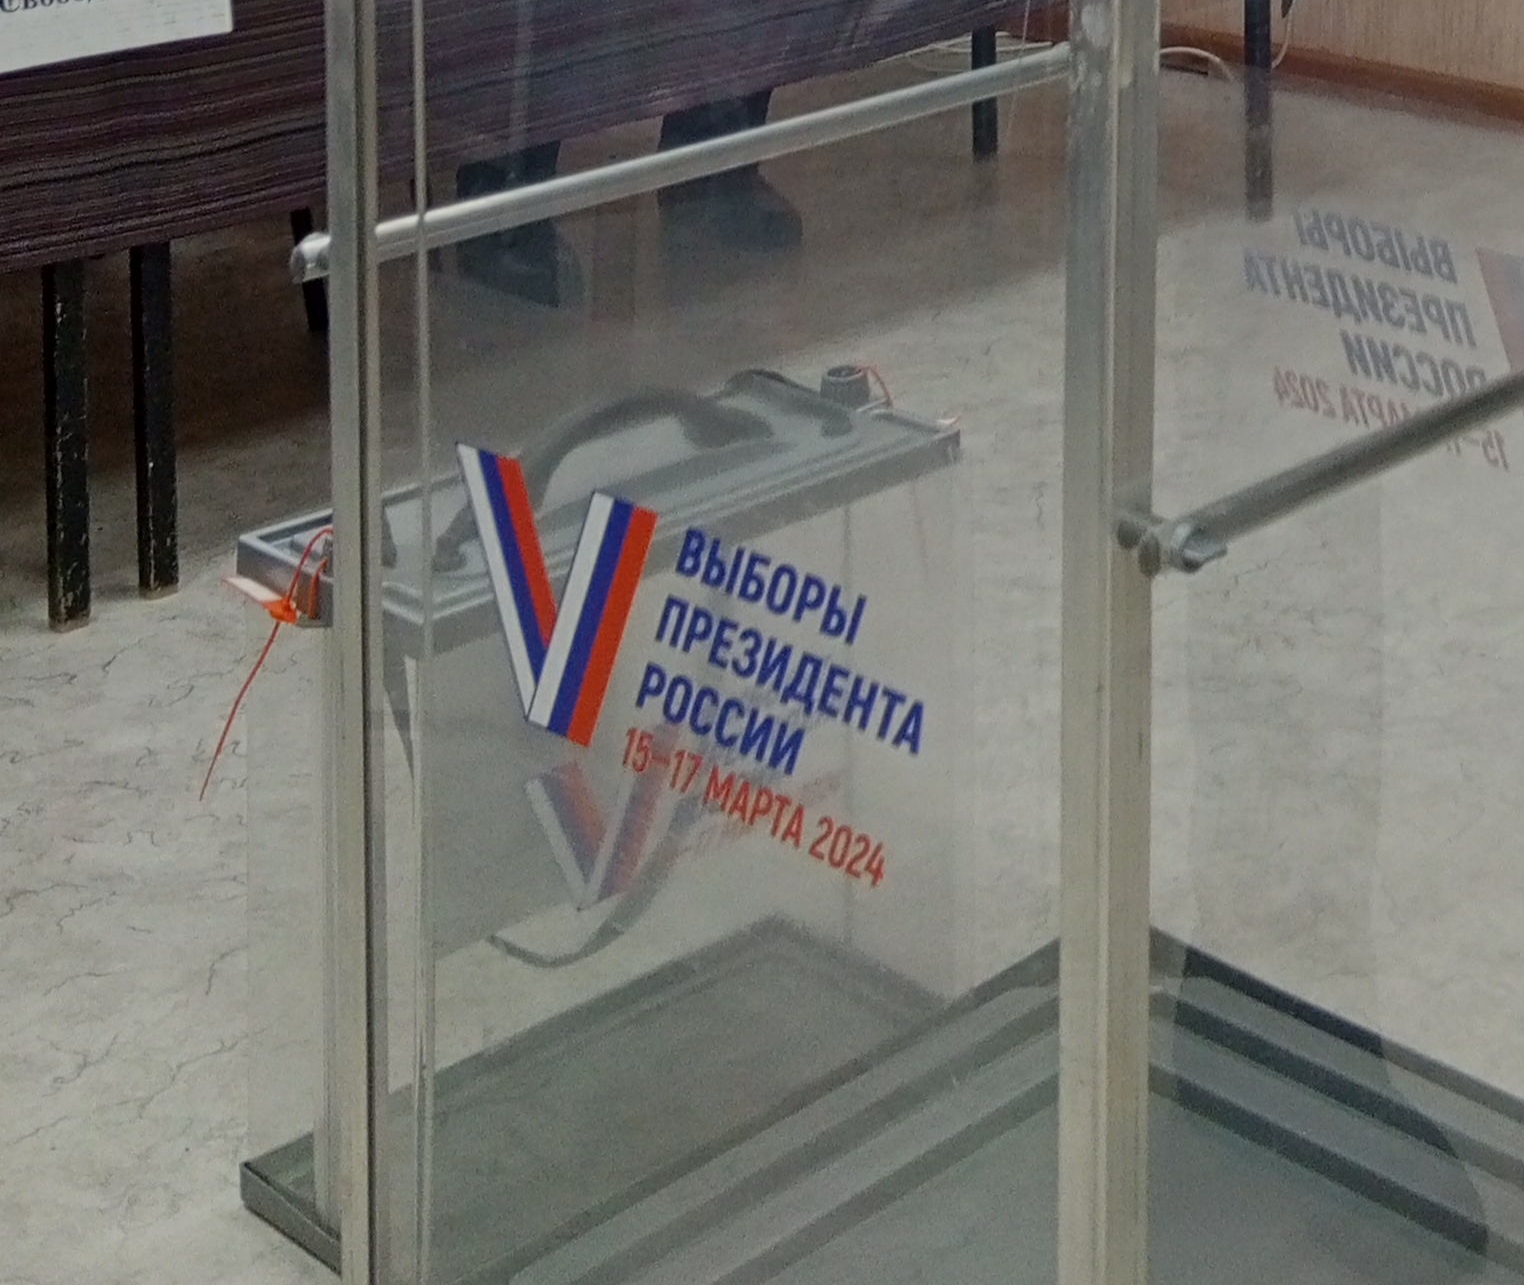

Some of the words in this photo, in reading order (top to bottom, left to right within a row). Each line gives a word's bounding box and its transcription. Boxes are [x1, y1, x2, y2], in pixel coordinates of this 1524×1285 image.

[674, 527, 867, 646] ВЫБОРЫ
[635, 663, 804, 775] РОССИИ
[654, 596, 924, 756] ПРЕЗИДЕНТА
[703, 765, 804, 849] МАРТА
[808, 816, 884, 887] 2024
